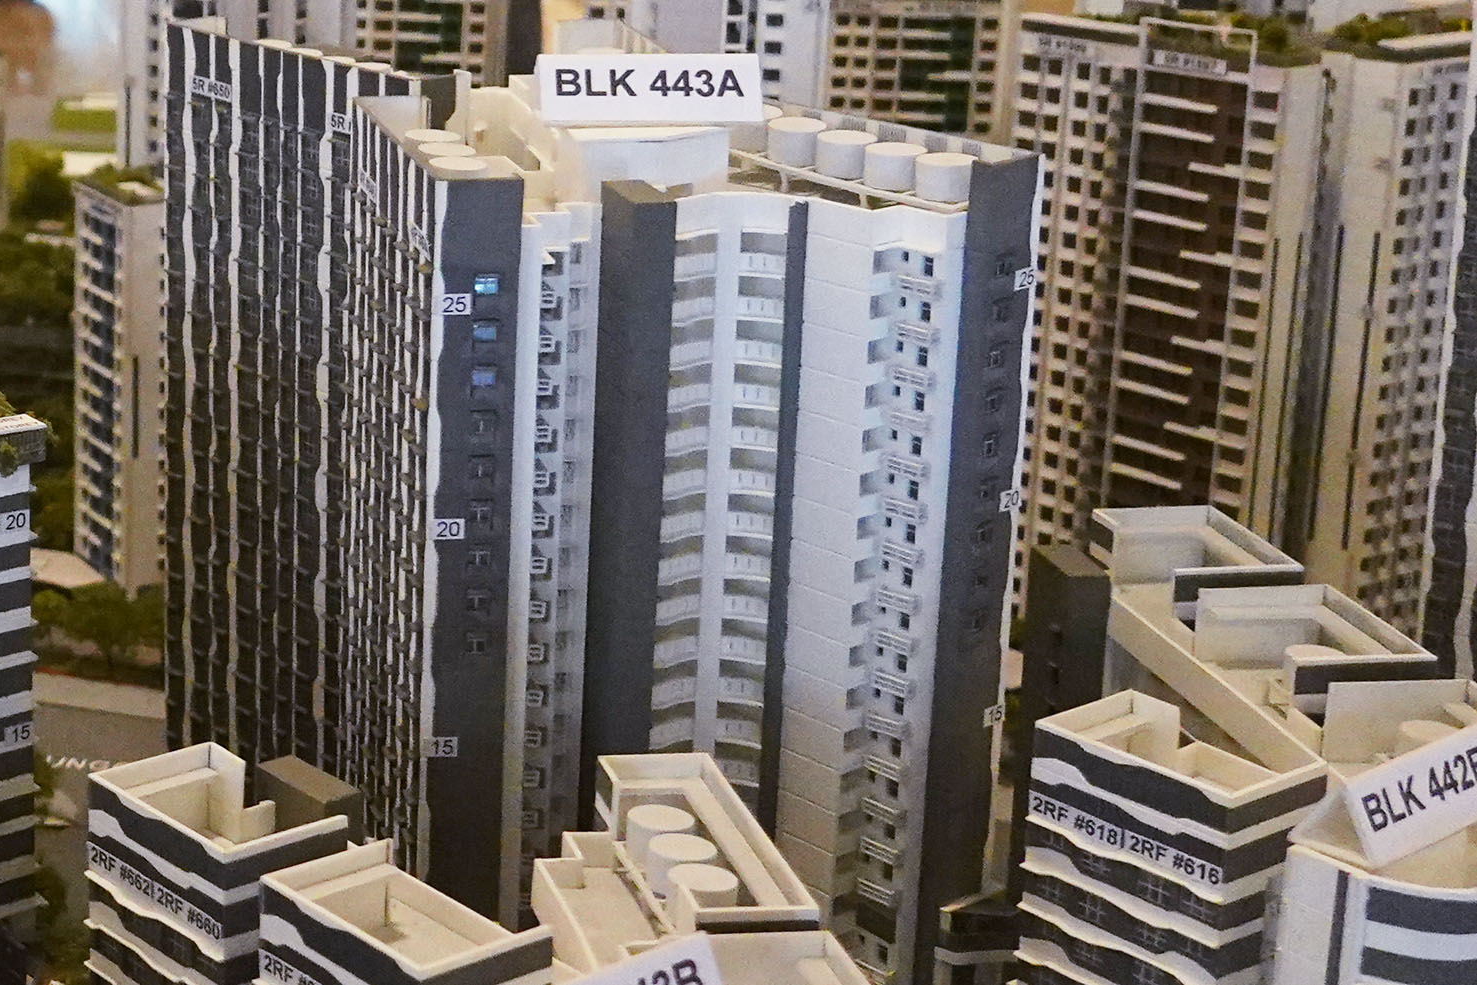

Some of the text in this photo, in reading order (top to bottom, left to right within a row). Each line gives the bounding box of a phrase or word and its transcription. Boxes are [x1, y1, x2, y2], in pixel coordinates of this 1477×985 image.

[555, 68, 745, 98] BLK 443A
[443, 296, 466, 313] 25
[1004, 490, 1019, 508] 20
[6, 512, 26, 530] 20
[436, 521, 460, 537] 20
[988, 705, 1002, 723] 15
[12, 725, 30, 742] 15
[431, 739, 453, 755] 15
[1361, 775, 1426, 832] BLK
[1032, 796, 1220, 885] 2RF #618 2RF #616
[91, 846, 220, 940] 2RF #662 2RF #660
[264, 954, 293, 982] 2RF
